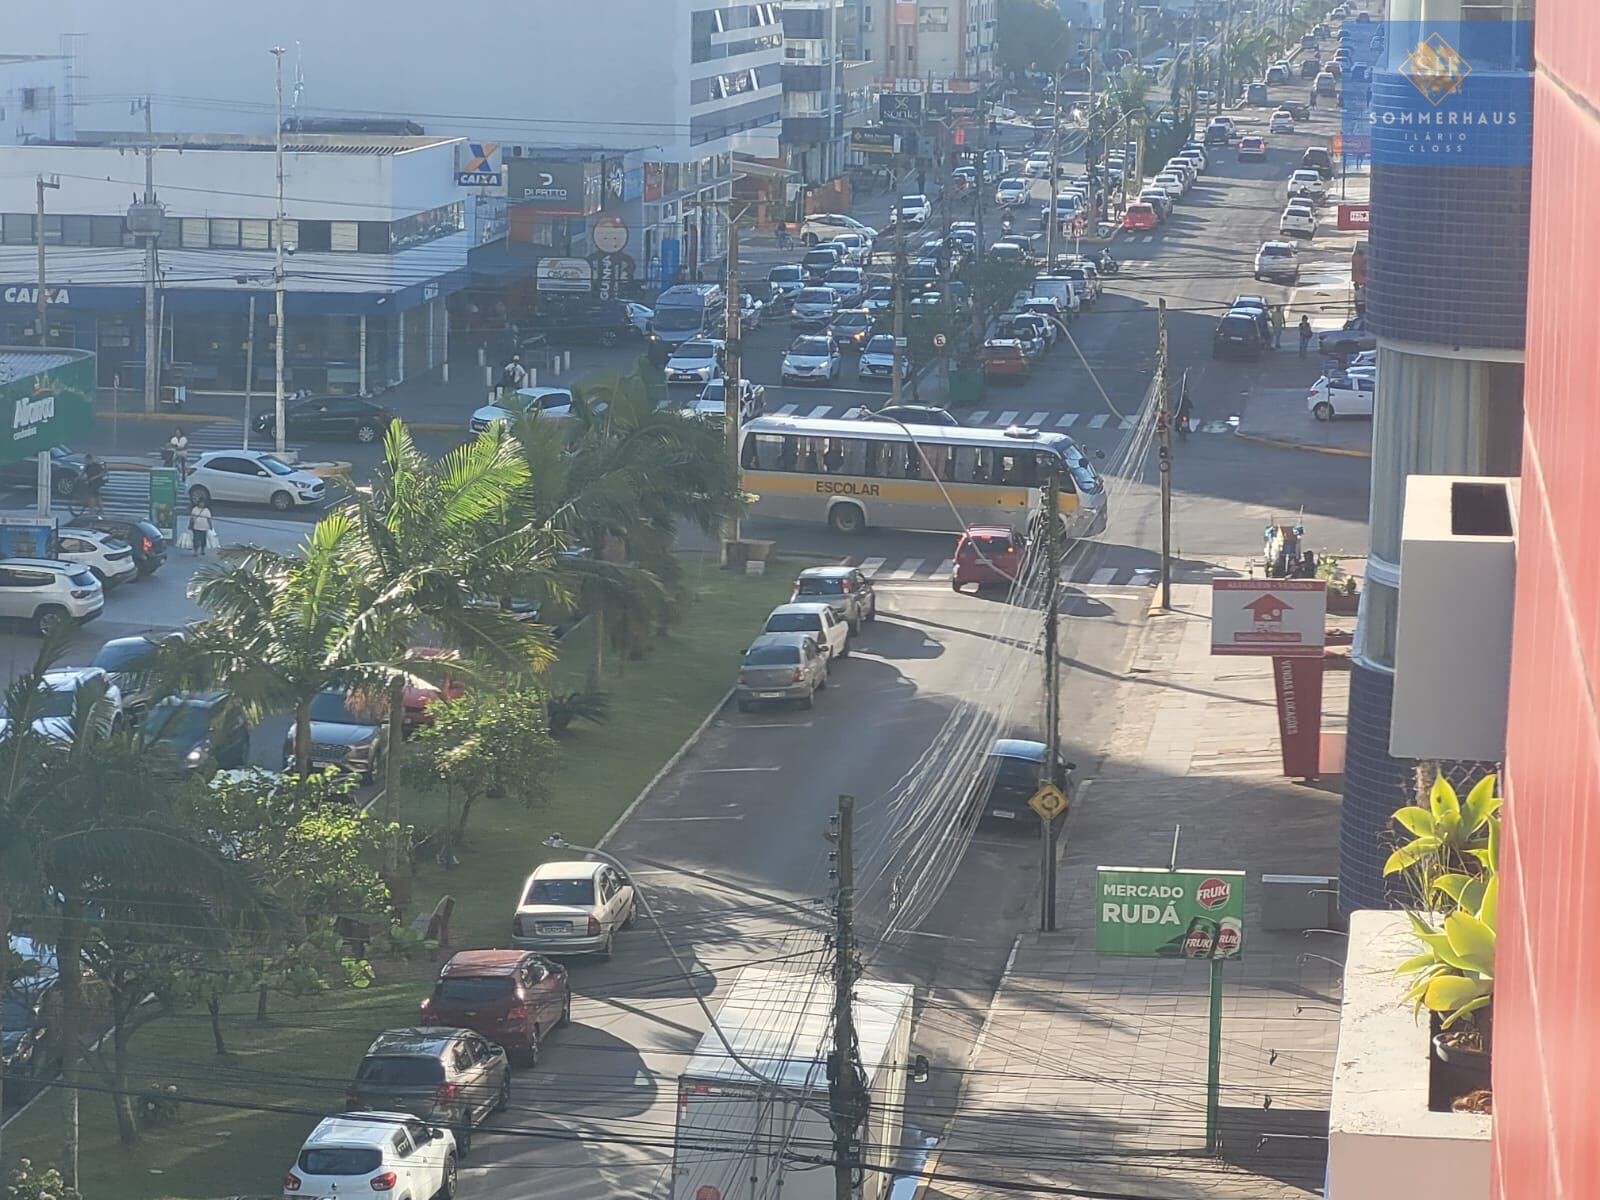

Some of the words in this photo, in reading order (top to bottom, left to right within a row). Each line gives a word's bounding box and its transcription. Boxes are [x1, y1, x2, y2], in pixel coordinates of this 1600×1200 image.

[895, 78, 953, 93] HOTEL
[460, 174, 498, 185] CAIXA
[4, 287, 70, 304] CAIXA
[816, 481, 880, 496] ESCOLAR
[1281, 660, 1294, 690] VENDAS
[1103, 884, 1184, 898] MERCADO
[1196, 883, 1231, 901] FRUKI
[1102, 900, 1181, 925] RUDÁ
[1185, 938, 1213, 949] FRUKI
